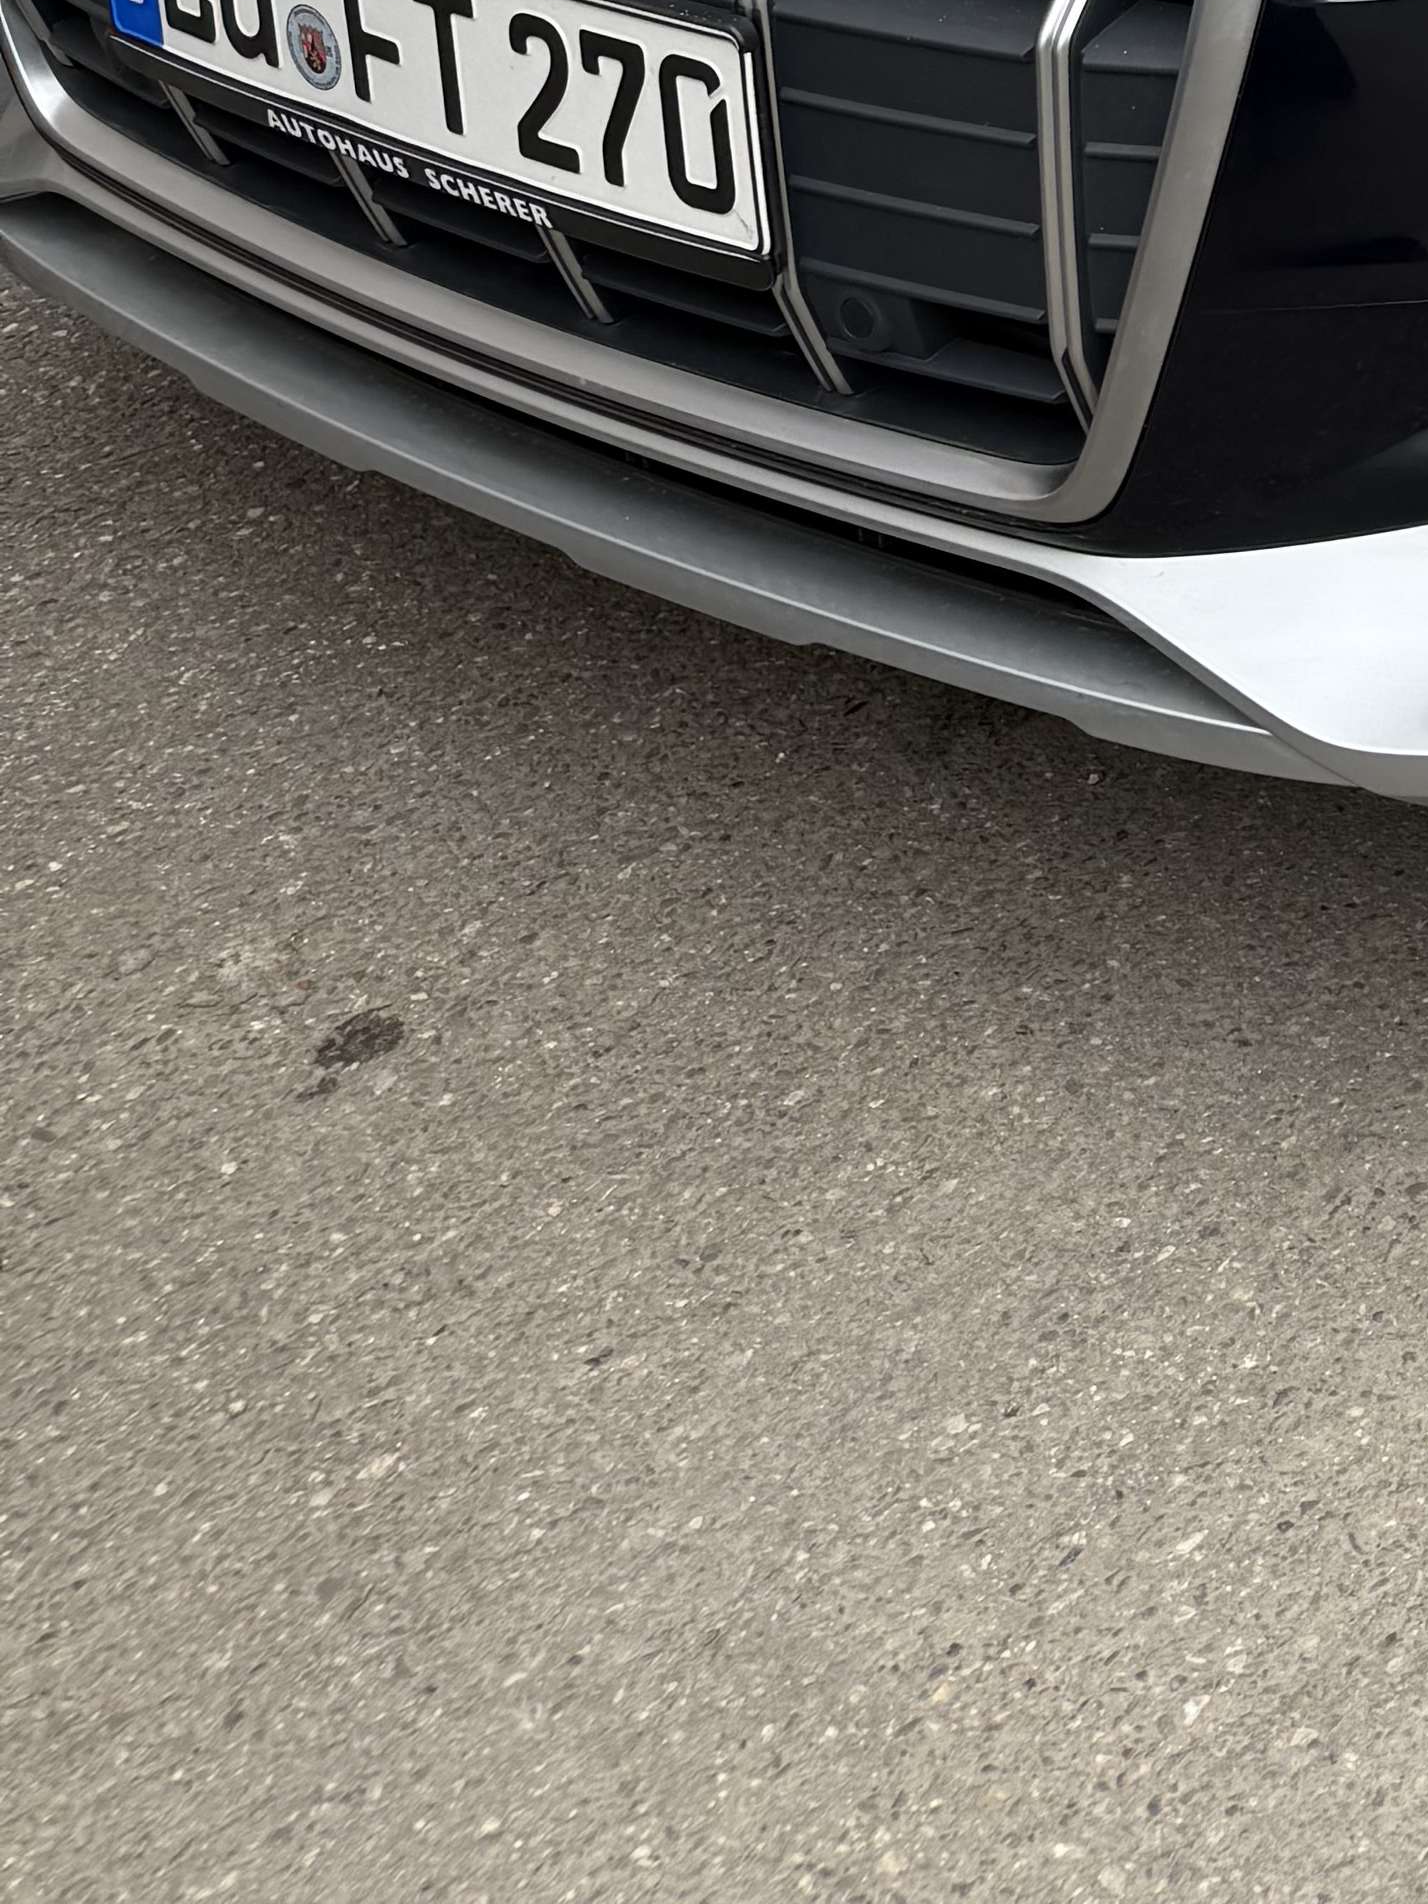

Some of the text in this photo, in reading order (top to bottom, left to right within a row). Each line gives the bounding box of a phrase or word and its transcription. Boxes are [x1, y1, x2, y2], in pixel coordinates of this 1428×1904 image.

[266, 108, 554, 230] AUTOHAUS SCHERER
[508, 12, 736, 216] 270
